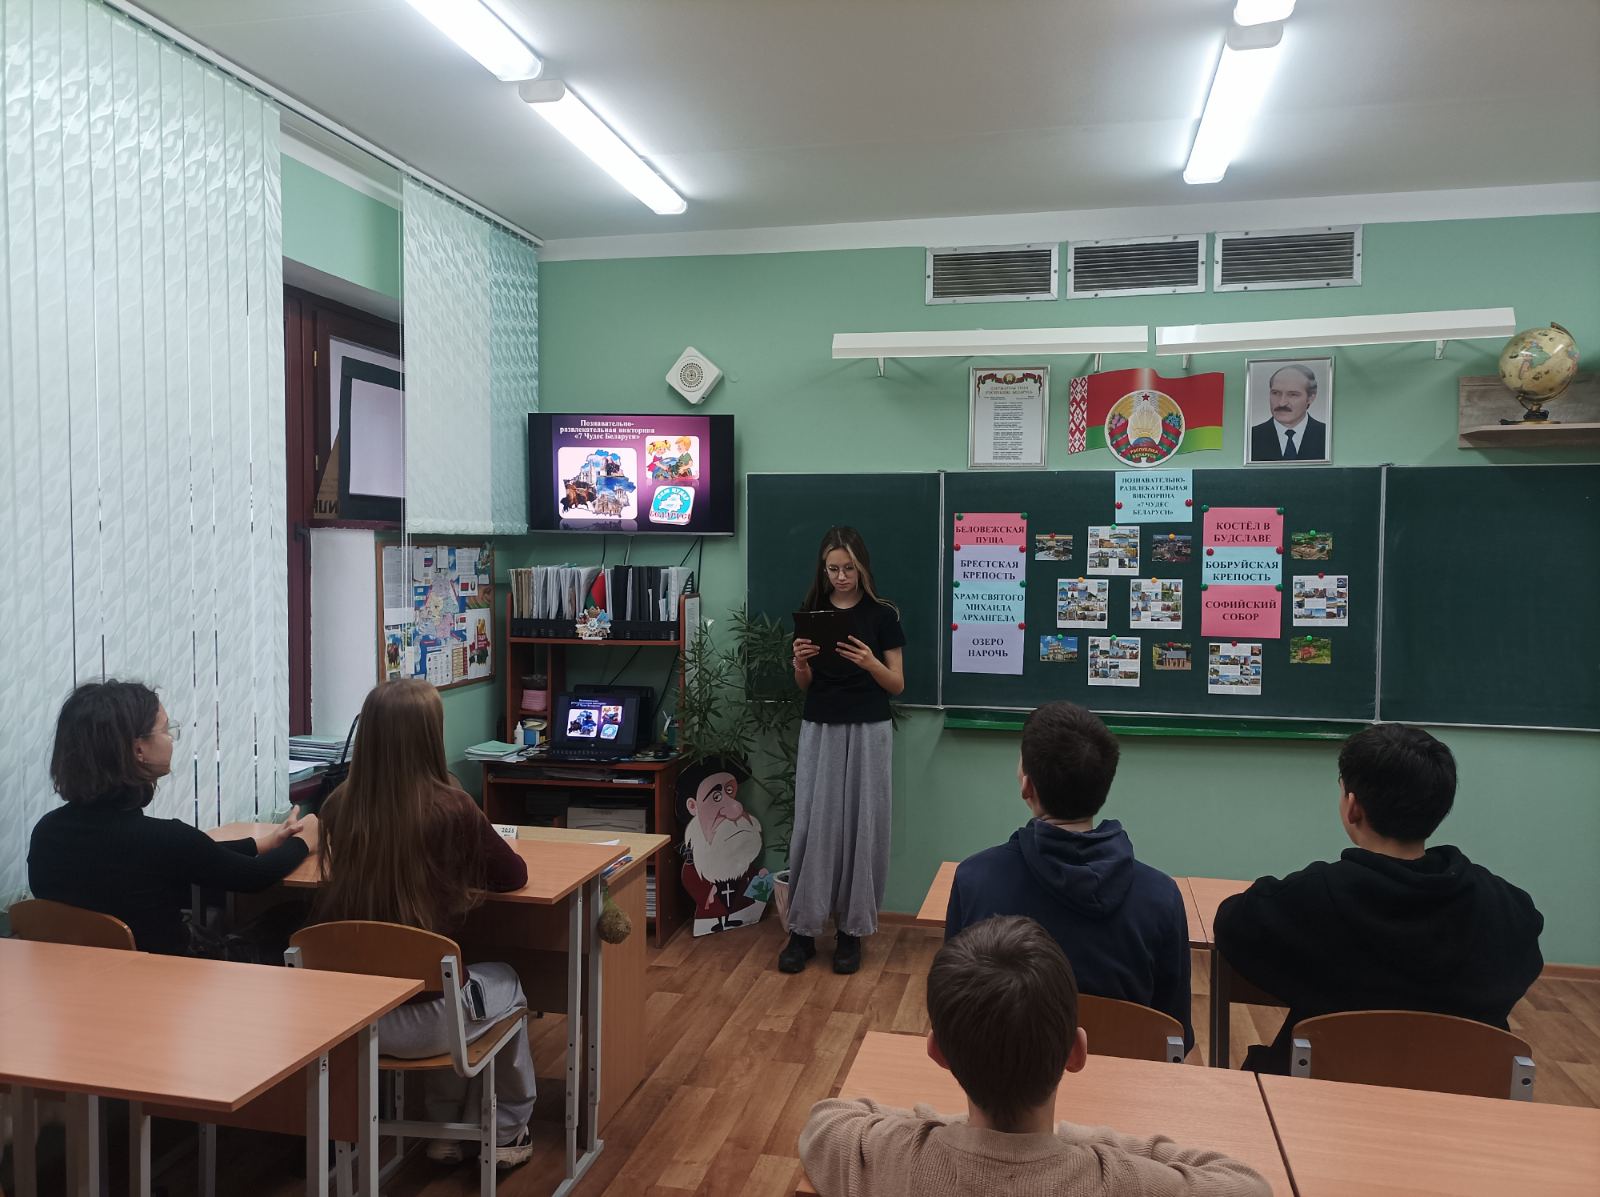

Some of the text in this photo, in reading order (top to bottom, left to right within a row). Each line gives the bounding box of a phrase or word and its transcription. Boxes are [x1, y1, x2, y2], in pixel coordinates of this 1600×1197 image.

[580, 419, 634, 427] Познавательно-
[1216, 521, 1271, 530] КОСТЁЛ В
[1213, 534, 1272, 543] БУДСЛАВЕ
[960, 559, 1019, 568] БРЕСТСКАЯ
[1205, 560, 1279, 569] БОБРУЙСКАЯ
[963, 571, 1016, 580] КРЕПОСТЬ
[1213, 573, 1271, 581] КРЕПОСТЬ
[954, 592, 1024, 601] ХРАМ СВЯТОГО
[966, 603, 1012, 612] МИХАИЛА
[1205, 600, 1277, 609] СОФИЙСКИЙ
[962, 614, 1016, 622] АРХАНГЕЛА
[1222, 613, 1260, 621] СОБОР
[972, 638, 1004, 646] ОЗЕРО
[968, 649, 1009, 657] НАРОЧЬ
